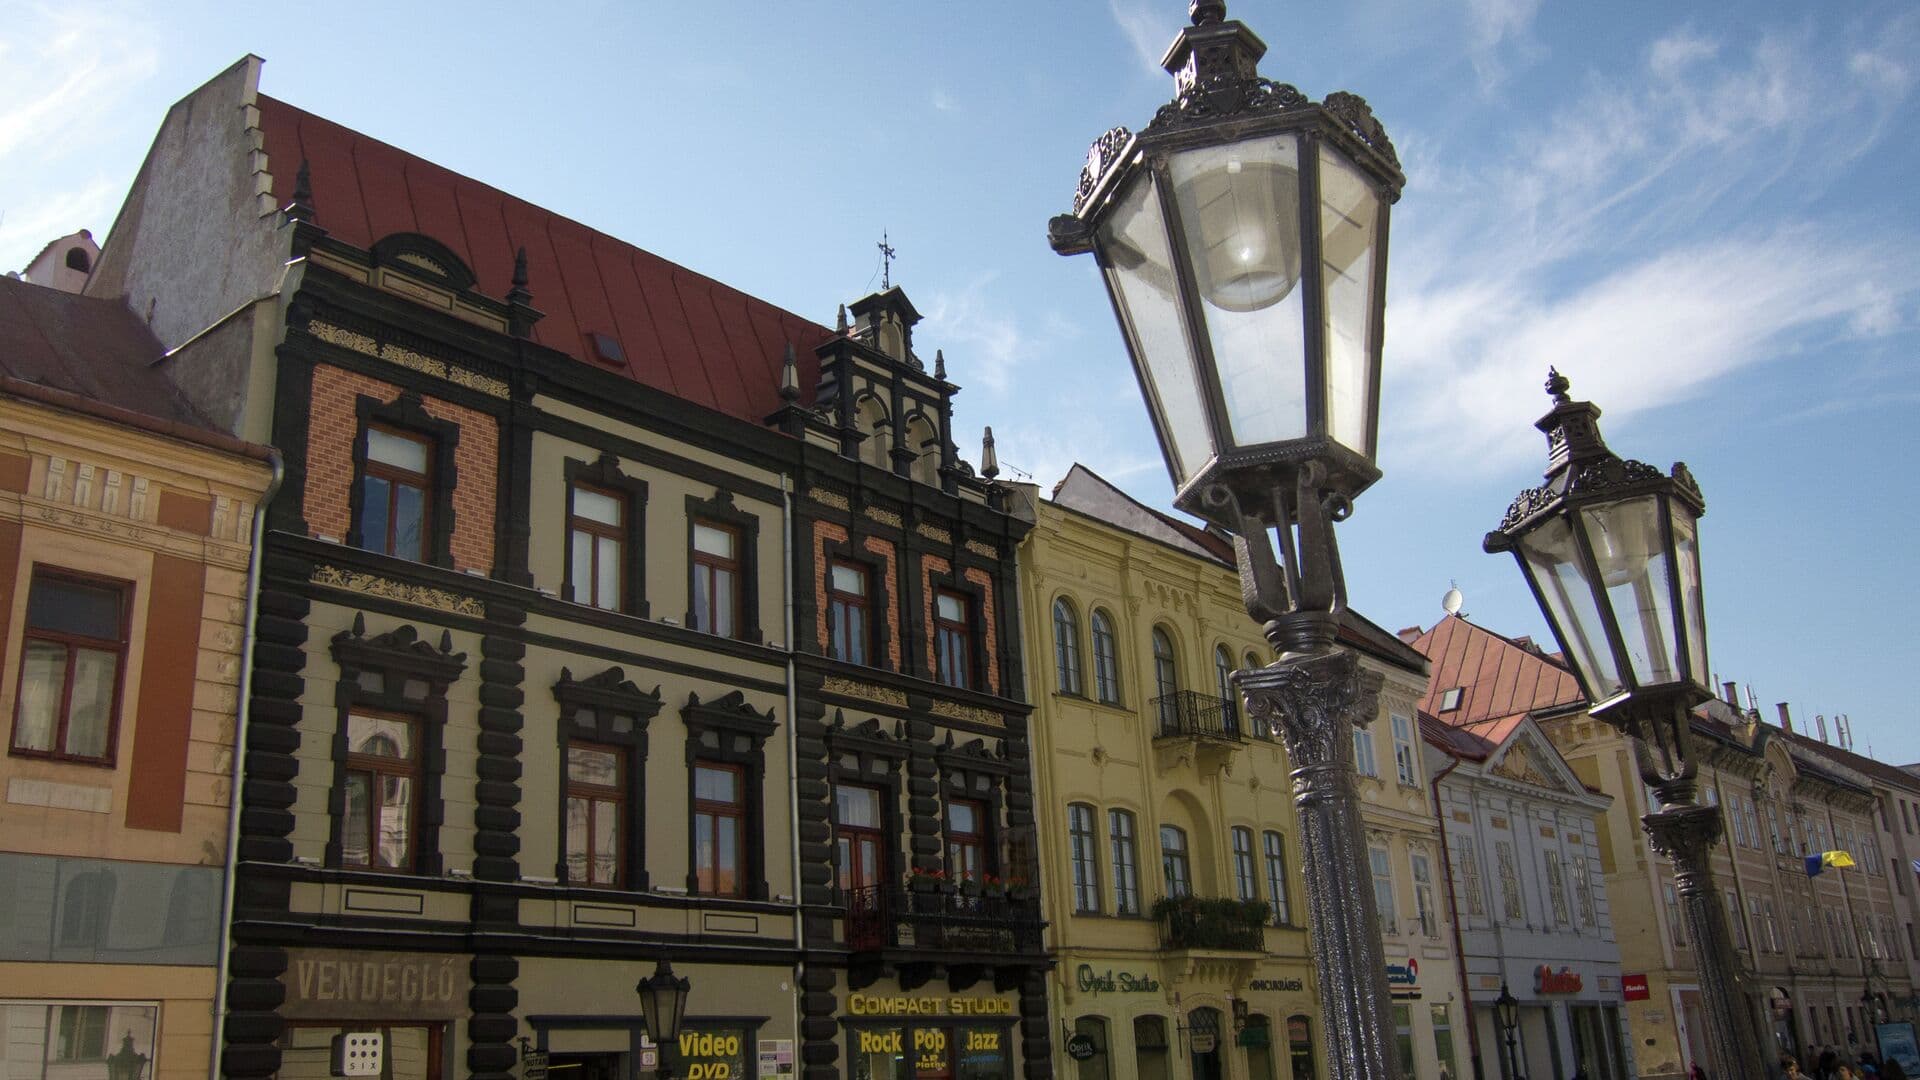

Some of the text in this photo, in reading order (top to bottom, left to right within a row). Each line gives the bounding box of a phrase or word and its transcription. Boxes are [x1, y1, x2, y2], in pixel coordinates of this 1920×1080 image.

[297, 958, 455, 1001] VENDÉGLŐ
[950, 997, 1012, 1015] STUDIO
[679, 1032, 738, 1057] Video
[860, 1030, 902, 1053] Rock
[913, 1029, 945, 1053] Pop
[966, 1030, 999, 1051] Jazz
[350, 1062, 377, 1070] SIX
[688, 1063, 729, 1080] DVD
